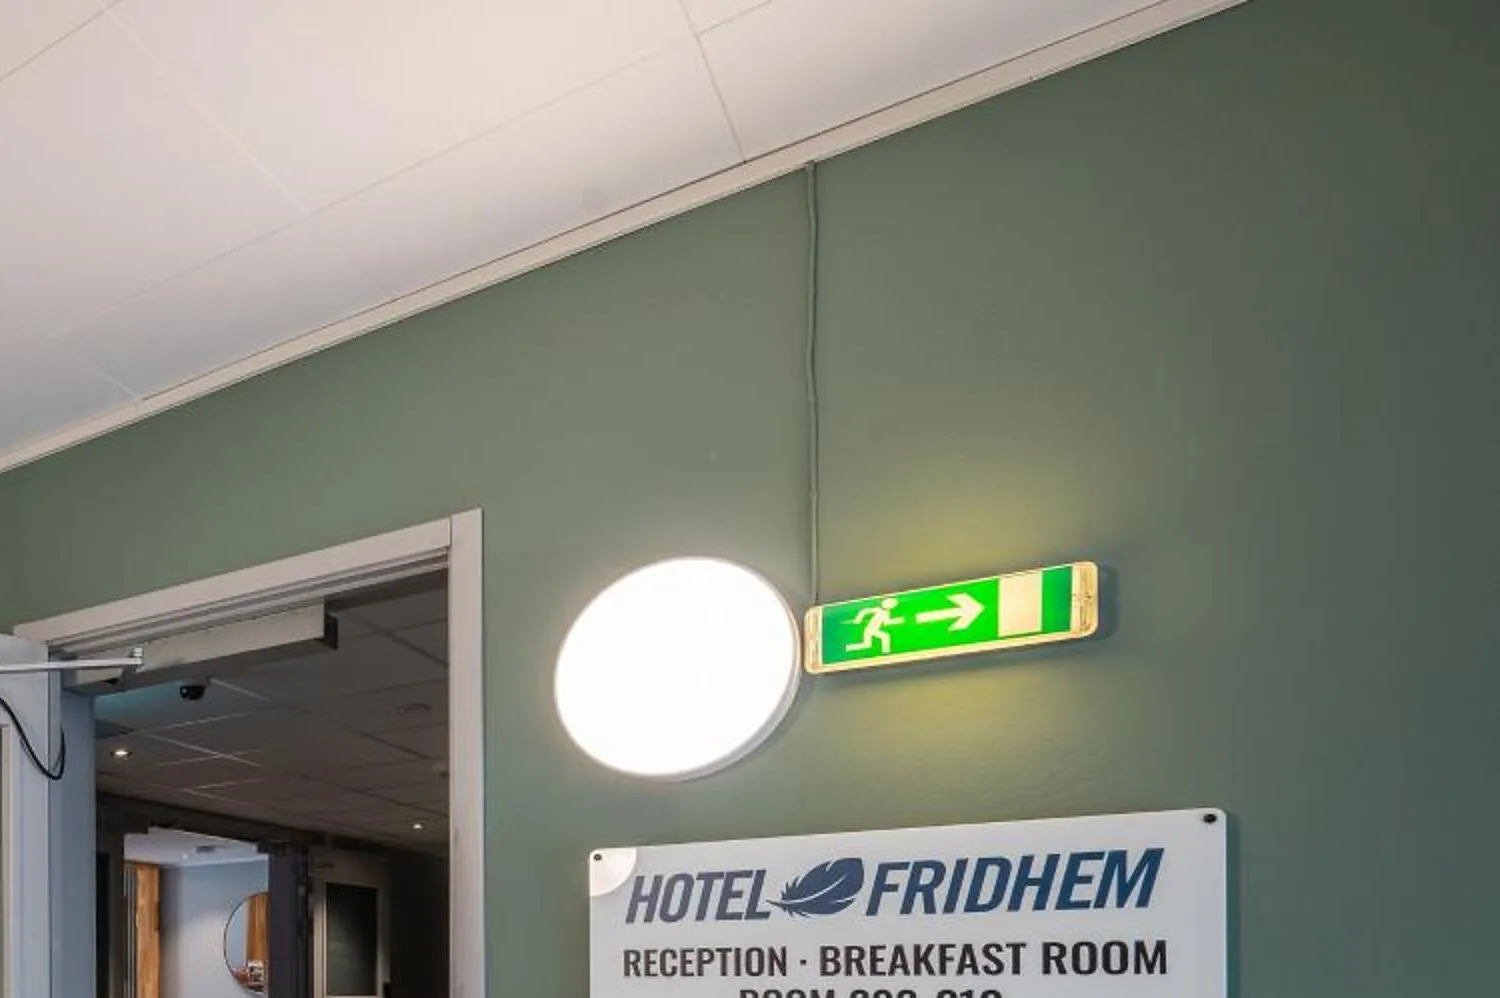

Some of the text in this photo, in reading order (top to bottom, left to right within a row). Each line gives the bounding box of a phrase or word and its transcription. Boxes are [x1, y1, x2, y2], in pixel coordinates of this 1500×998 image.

[625, 847, 1165, 924] HOTEL FRIDHEM
[623, 945, 788, 977] RECEPTION
[819, 942, 1027, 977] BREAKFAST
[1041, 939, 1168, 976] ROOM
